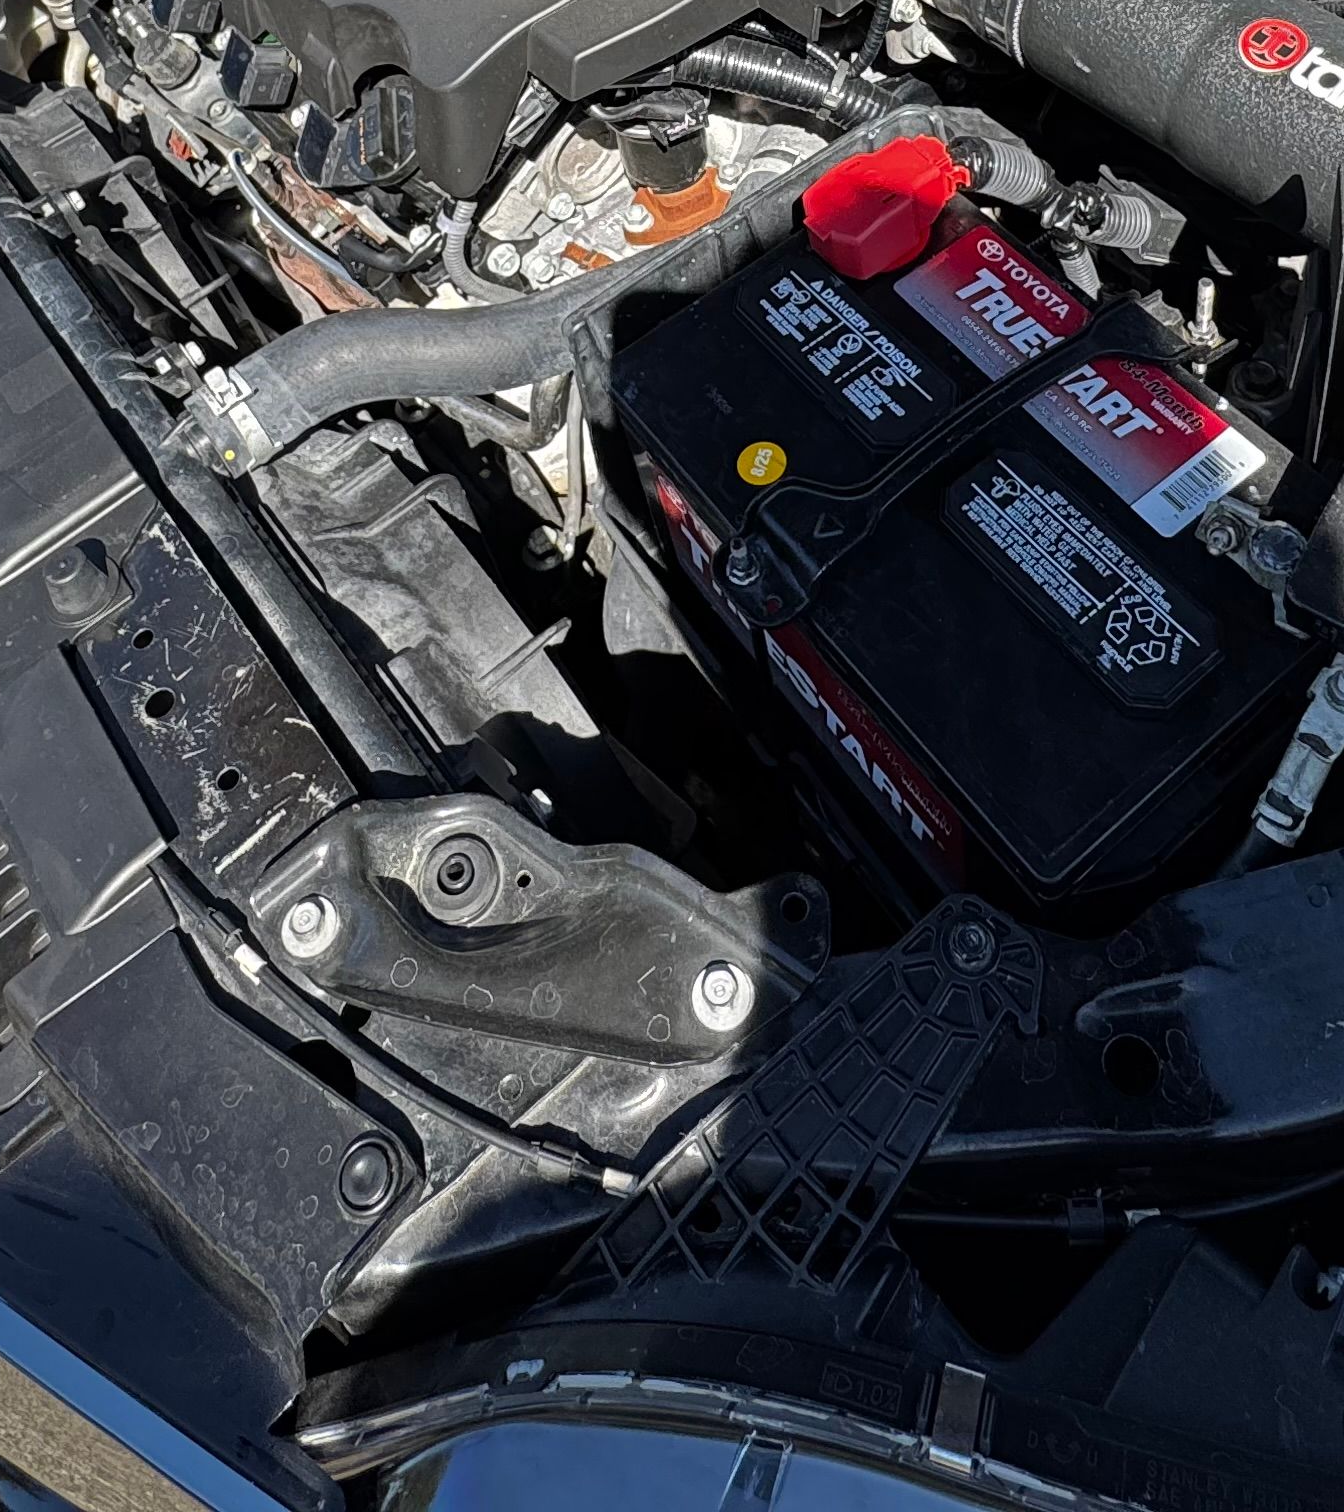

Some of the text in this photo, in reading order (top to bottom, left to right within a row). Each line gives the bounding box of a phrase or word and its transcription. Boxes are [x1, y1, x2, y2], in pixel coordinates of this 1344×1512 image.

[1002, 257, 1070, 320] TOYOTA
[1150, 398, 1195, 436] WARRANTY
[749, 447, 774, 478] 8/25
[1011, 498, 1035, 519] WITH
[1055, 539, 1077, 558] GET
[1018, 491, 1047, 517] FLUSH
[1041, 513, 1065, 534] EYES
[1065, 504, 1082, 518] OUT
[1002, 504, 1078, 573] MEDICAL HELP FAST
[1117, 561, 1139, 581] TIGHT
